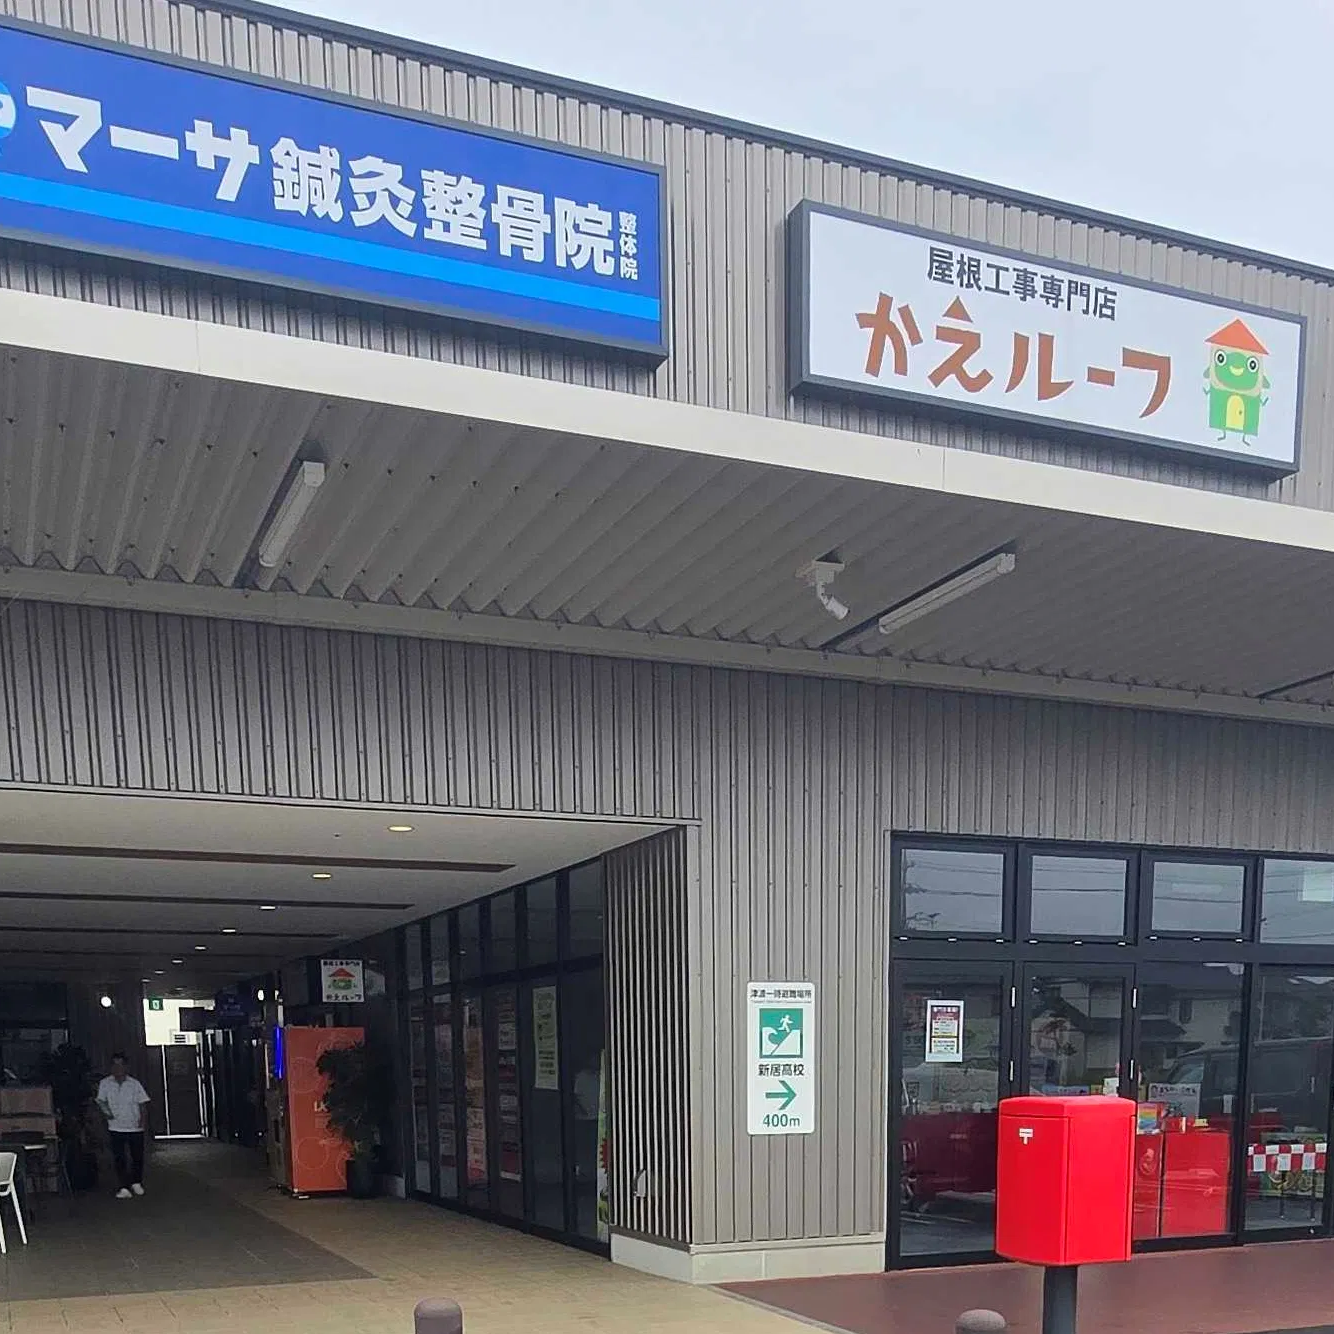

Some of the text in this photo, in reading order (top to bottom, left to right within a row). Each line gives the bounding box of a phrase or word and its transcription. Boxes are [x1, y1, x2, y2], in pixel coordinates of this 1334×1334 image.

[25, 86, 615, 277] マーサ鍼灸整骨院
[619, 211, 638, 281] 整体院
[927, 246, 1117, 320] 屋根工事専門店
[855, 291, 1172, 419] かえルーフ
[758, 1064, 805, 1077] 新居高校
[762, 1113, 801, 1128] 400m
